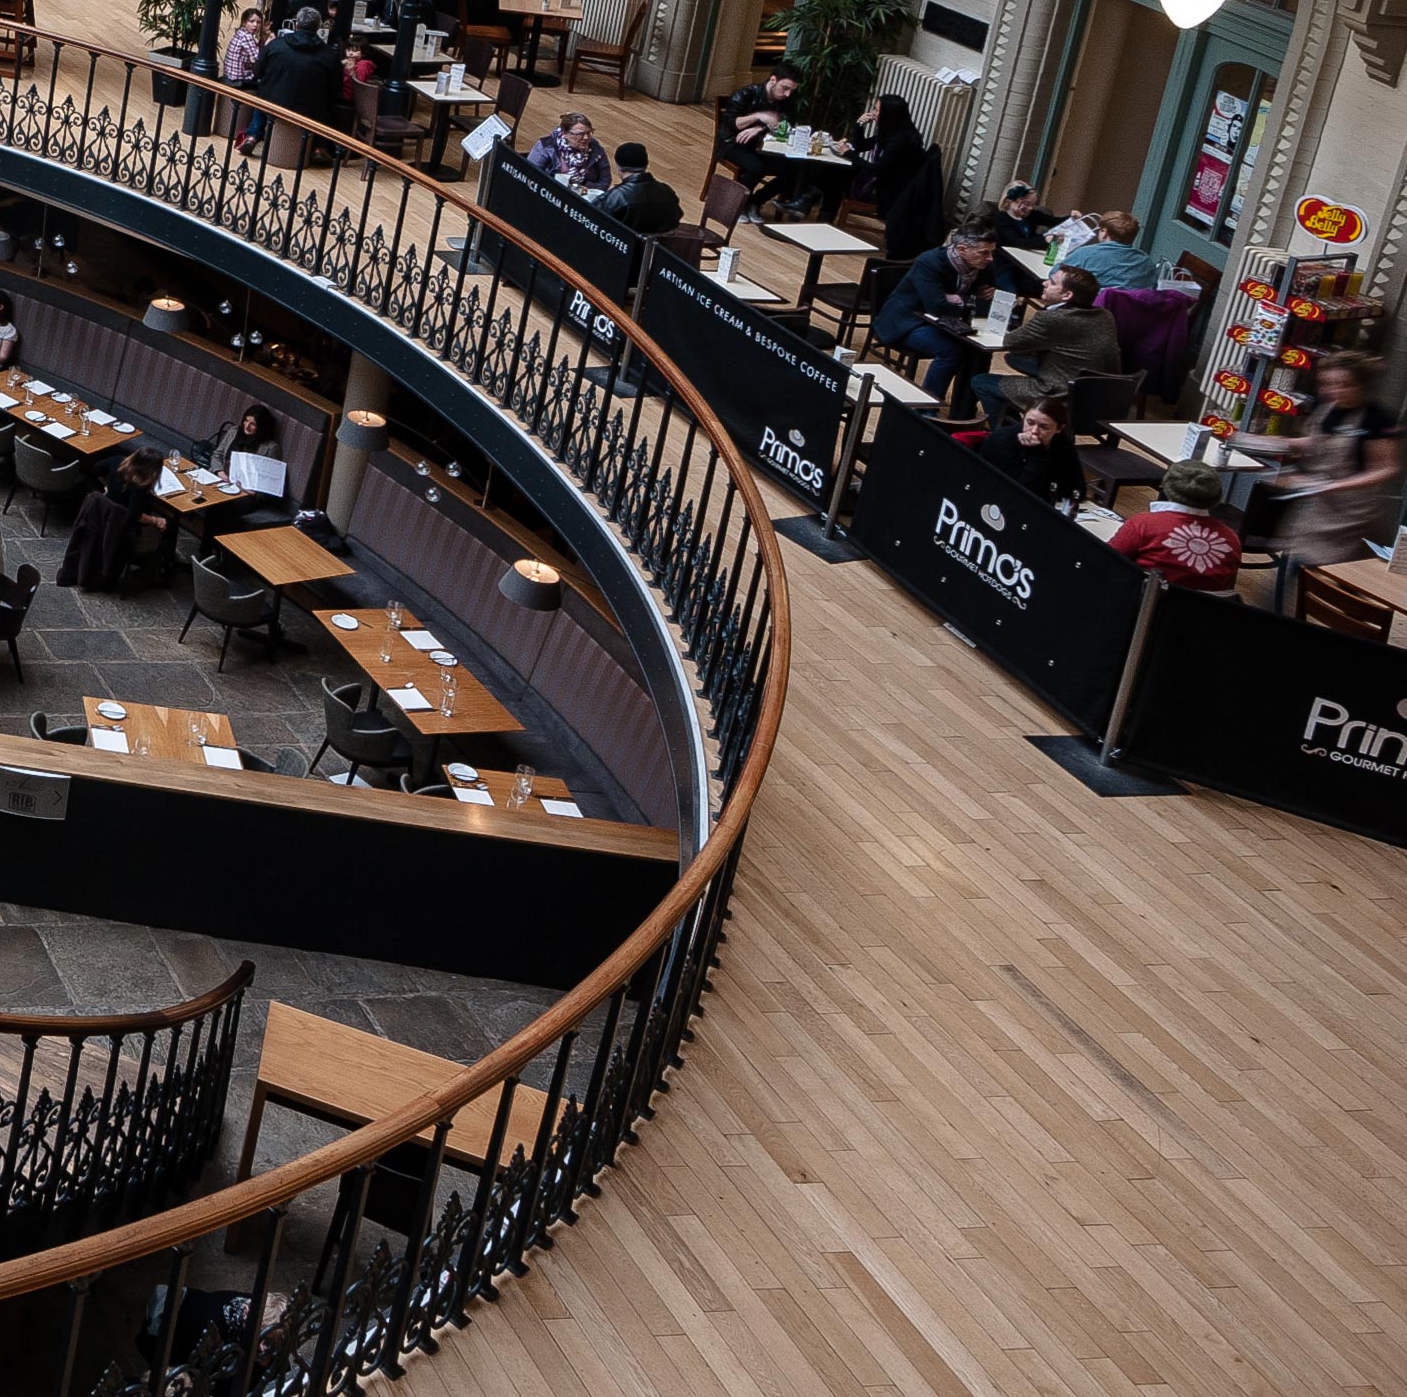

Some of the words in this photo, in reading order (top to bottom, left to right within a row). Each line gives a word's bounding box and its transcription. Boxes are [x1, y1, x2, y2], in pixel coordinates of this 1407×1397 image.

[501, 161, 528, 184] ARTISAN
[527, 178, 539, 193] ICE
[540, 187, 562, 209] CREAM
[563, 204, 569, 214] &
[569, 207, 599, 235] BESPOKE
[599, 229, 629, 254] COFFEE
[1305, 216, 1339, 238] Belly
[1318, 205, 1347, 228] Jelly
[659, 267, 695, 297] ARTISAN
[696, 291, 712, 310] ICE
[713, 304, 744, 331] CREAM
[745, 325, 752, 338] &
[755, 331, 797, 367] BESPOKE
[799, 360, 839, 393] COFFEE
[759, 425, 824, 490] Primo's
[935, 497, 1035, 600] Primo's
[945, 544, 979, 574] GOURMET
[978, 570, 1013, 601] HOTDOGS
[1329, 750, 1401, 778] GOURMET
